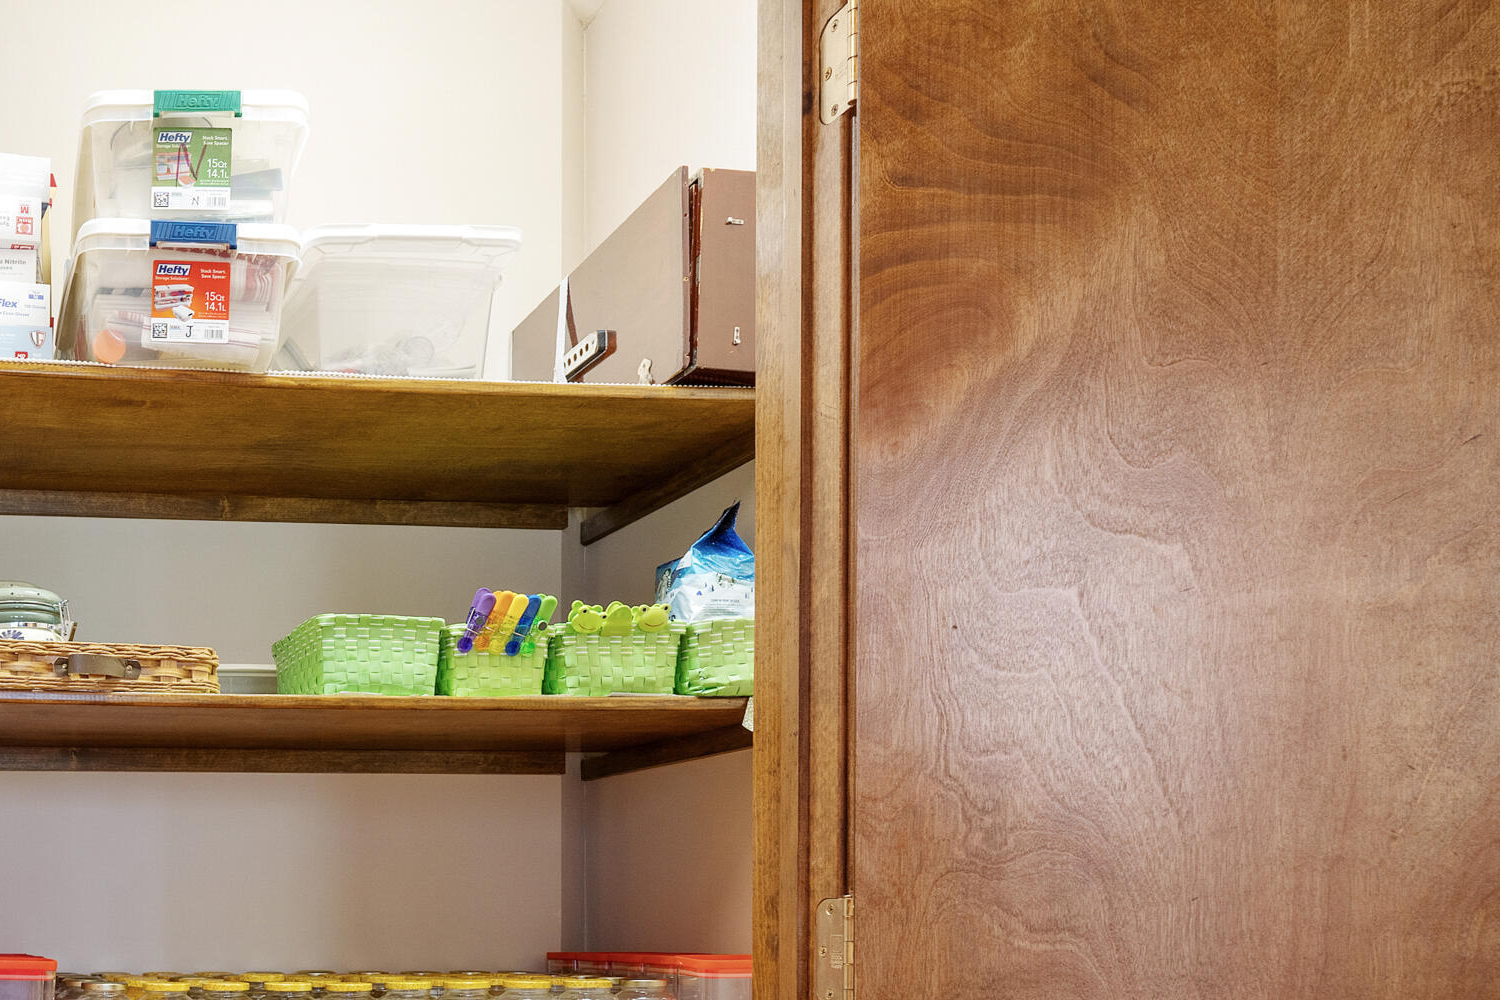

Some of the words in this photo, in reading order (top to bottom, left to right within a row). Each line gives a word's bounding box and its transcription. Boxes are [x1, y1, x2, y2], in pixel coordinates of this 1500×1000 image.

[160, 132, 190, 144] Hefty
[173, 226, 215, 239] Hefty
[158, 265, 190, 277] Hefty
[204, 302, 227, 312] 14.1L
